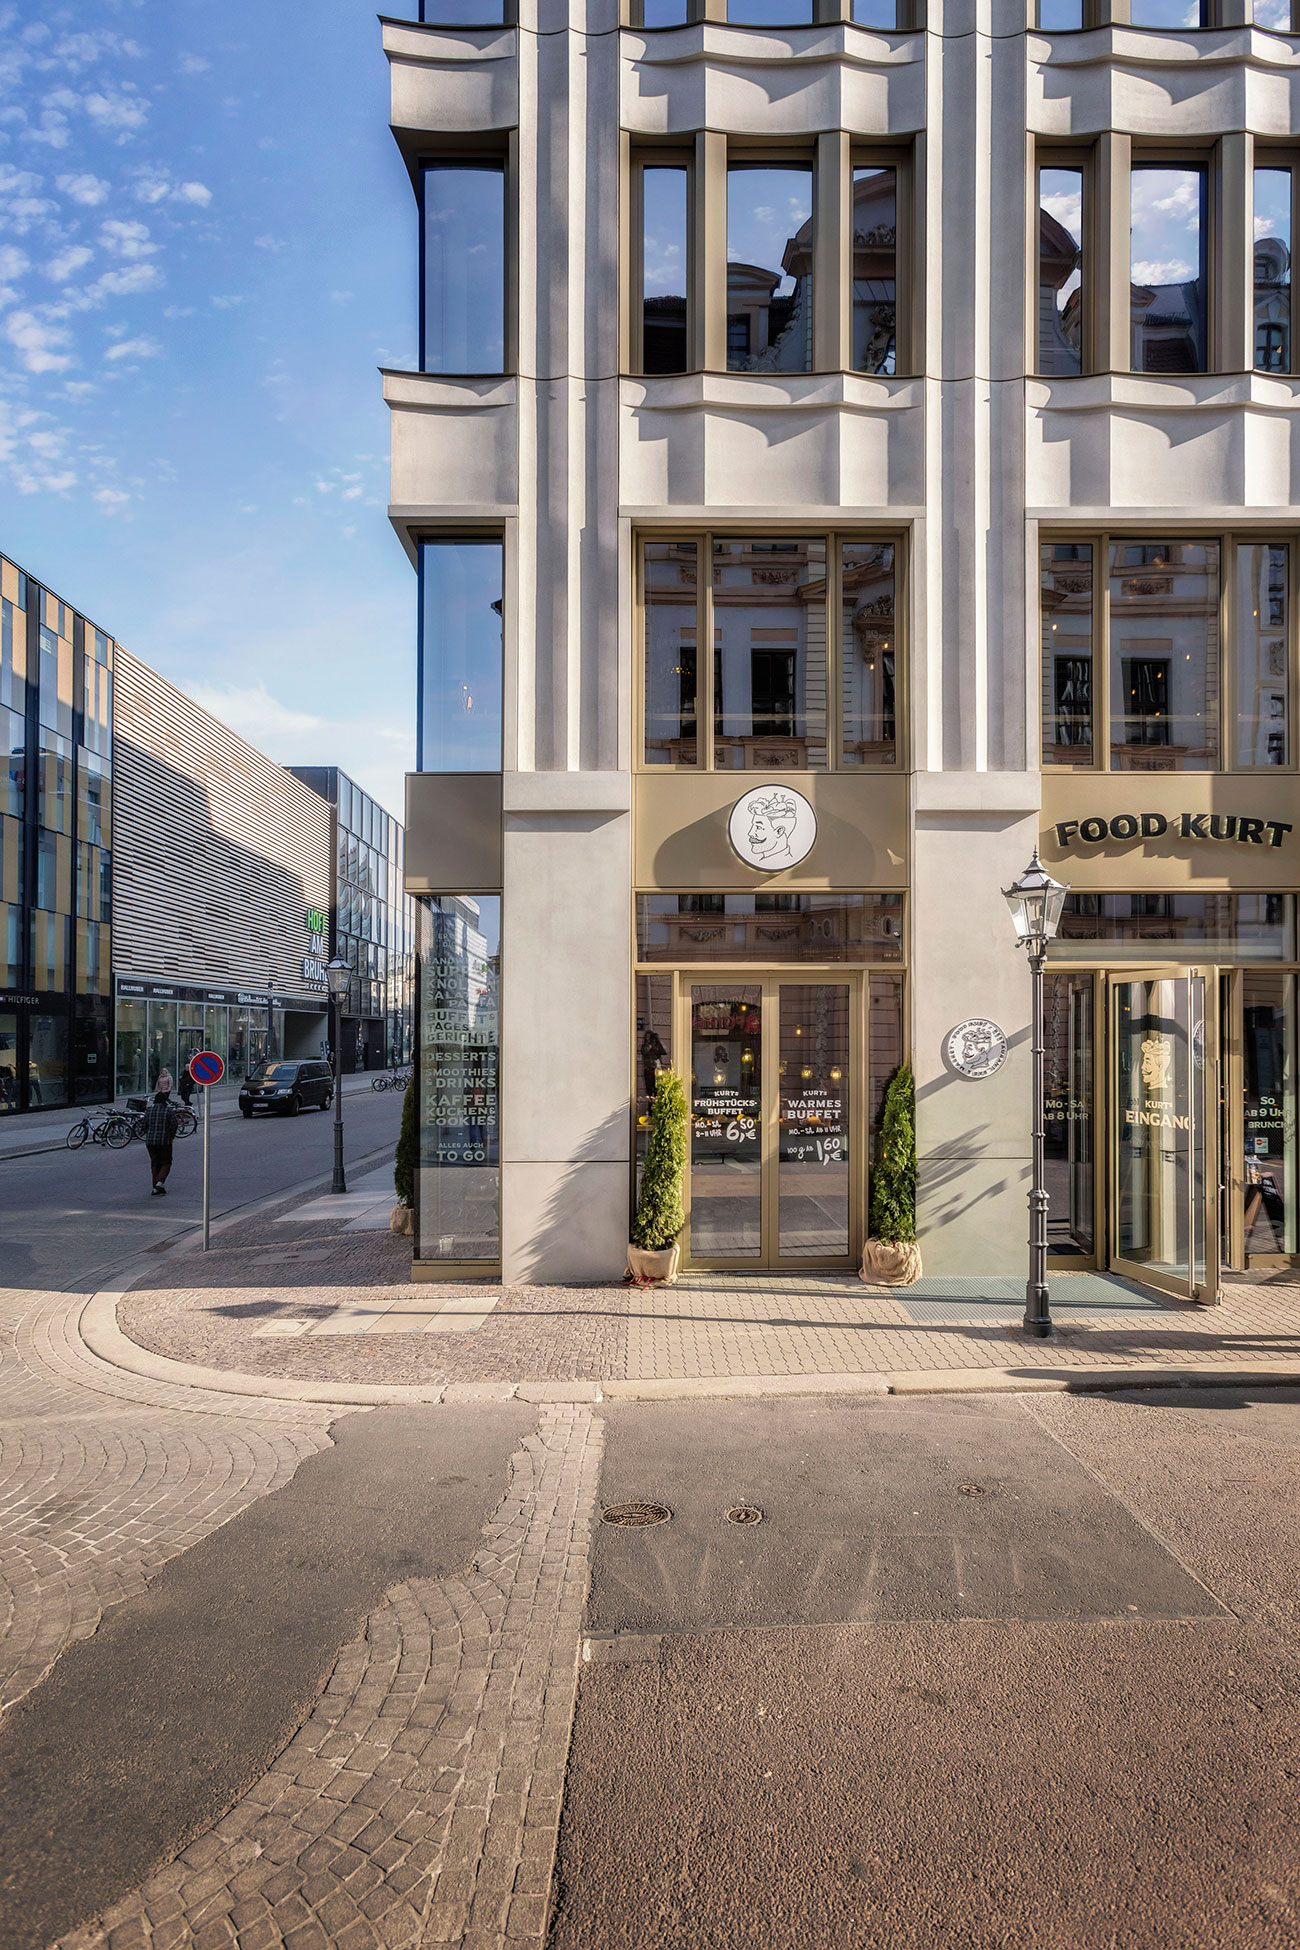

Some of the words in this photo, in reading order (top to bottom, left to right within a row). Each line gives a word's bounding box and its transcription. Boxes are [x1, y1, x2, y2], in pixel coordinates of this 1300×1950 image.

[1055, 813, 1168, 847] FOOD
[1180, 813, 1293, 848] KURT
[311, 934, 324, 955] AM
[427, 1052, 497, 1061] DESSERTS
[426, 1068, 497, 1076] SMOOTHIES
[436, 1078, 497, 1088] DRINKS
[427, 1094, 497, 1106] KAFFEE
[694, 1099, 758, 1107] FRÜHSTÜCKS-
[787, 1099, 842, 1108] WARMES
[787, 1109, 842, 1119] BUFFET
[1056, 1111, 1065, 1120] 8
[1244, 1109, 1258, 1117] AB
[1259, 1108, 1267, 1117] 9
[426, 1115, 497, 1126] COOKIES
[1125, 1110, 1196, 1130] EINGANG
[436, 1150, 458, 1161] TO
[463, 1150, 486, 1161] GO
